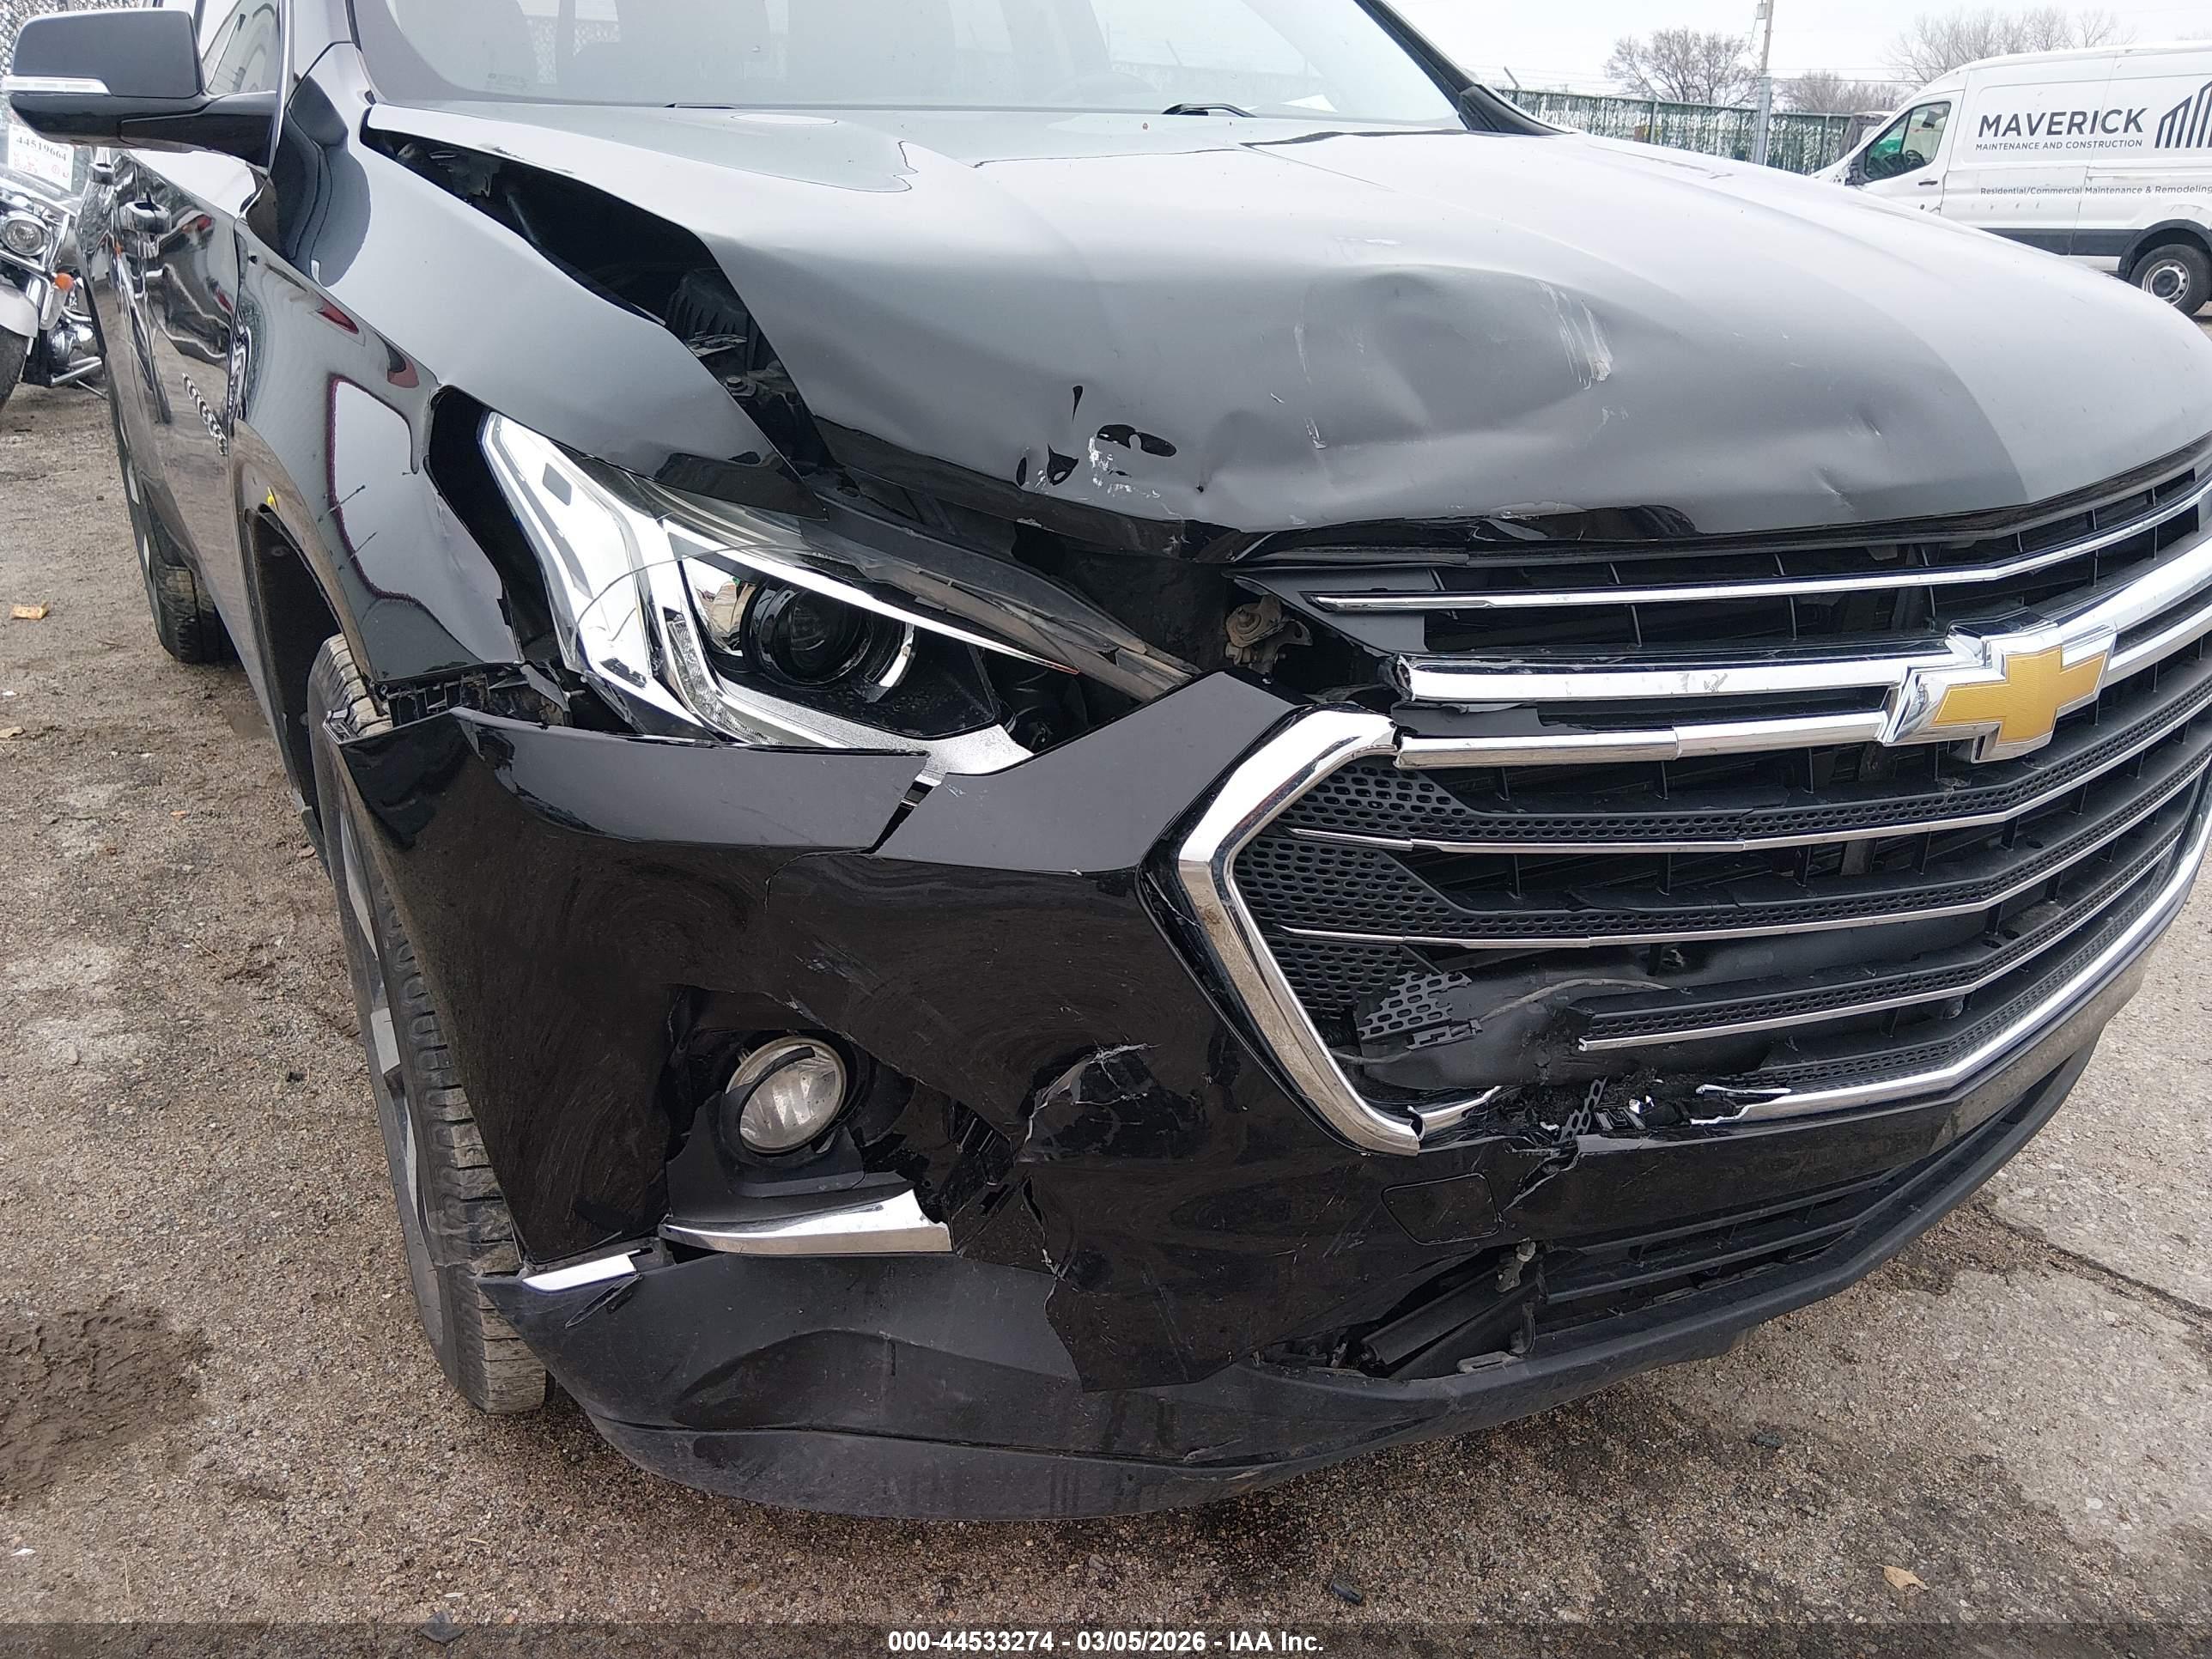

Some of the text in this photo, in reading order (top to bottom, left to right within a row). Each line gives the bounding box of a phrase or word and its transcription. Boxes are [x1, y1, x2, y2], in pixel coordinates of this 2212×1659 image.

[1978, 107, 2148, 137] MAVERICK
[1975, 139, 2143, 151] MAINTENANCE AND CONSTRUCTION
[1980, 185, 2212, 195] Residential/Commercial Maintenance & Remodeling
